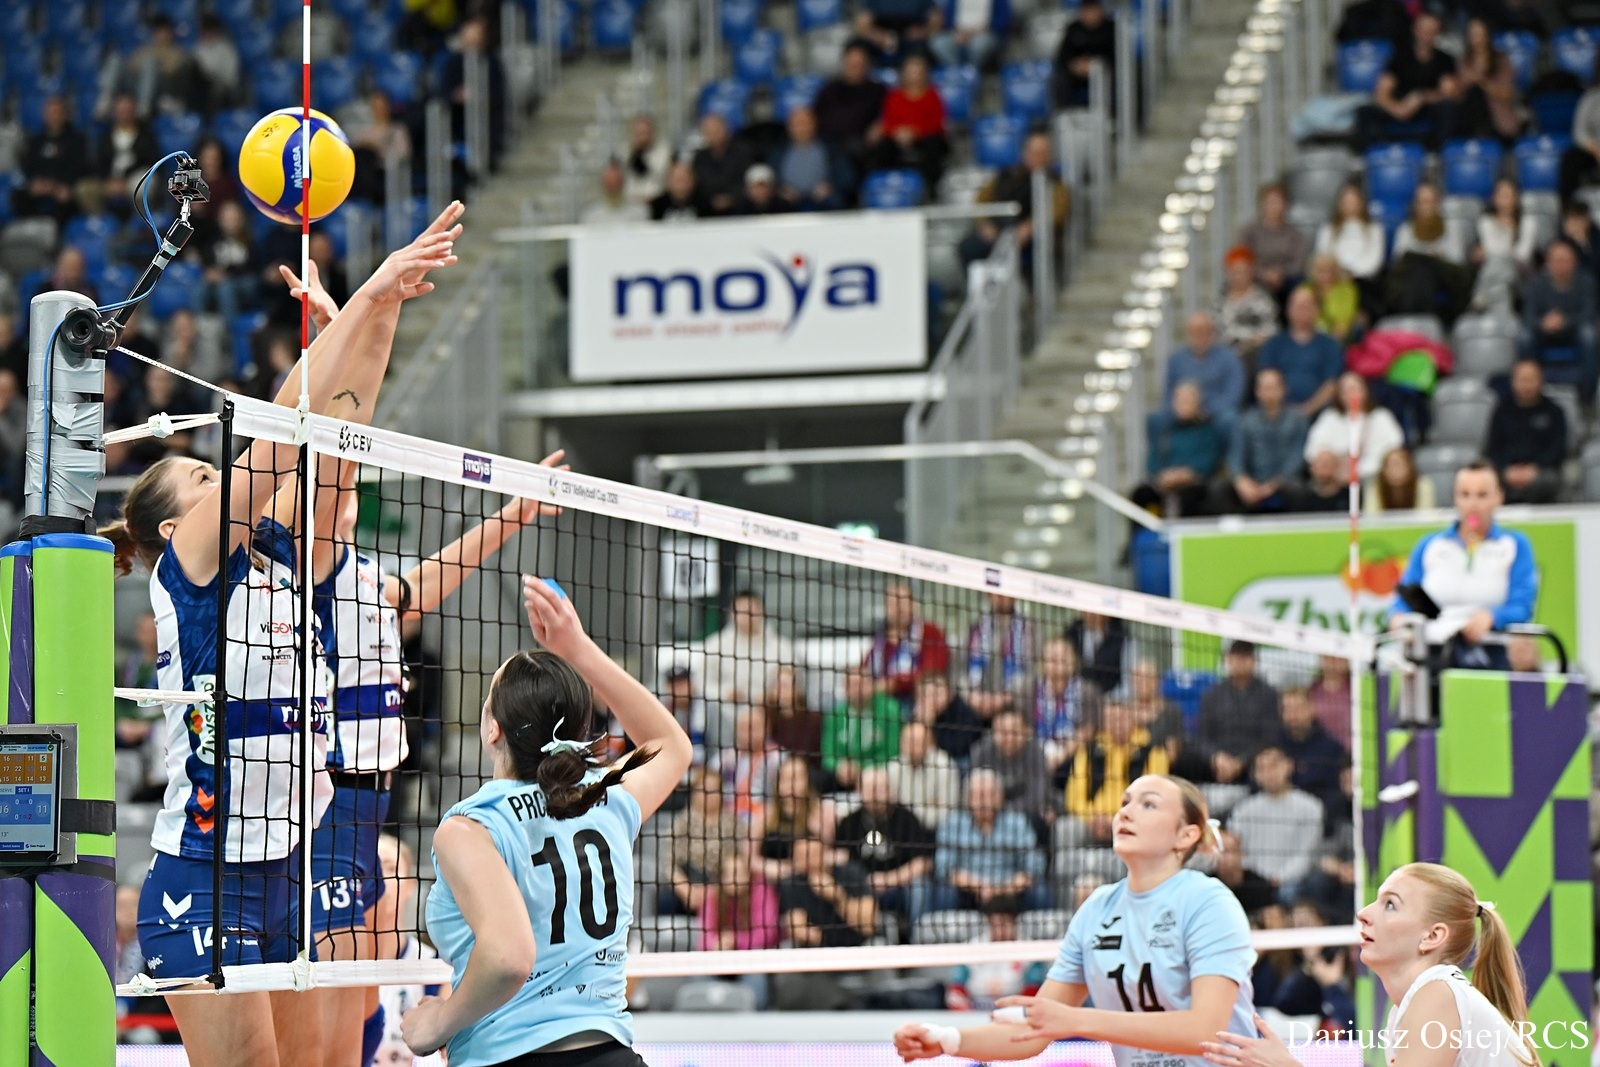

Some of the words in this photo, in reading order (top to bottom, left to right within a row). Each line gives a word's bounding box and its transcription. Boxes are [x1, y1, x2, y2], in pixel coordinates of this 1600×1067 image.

[614, 247, 880, 342] moya
[352, 434, 372, 453] CEV
[464, 458, 492, 478] moya
[312, 876, 351, 911] 13
[531, 829, 619, 945] 10
[192, 925, 228, 957] 14
[1107, 962, 1166, 1012] 14
